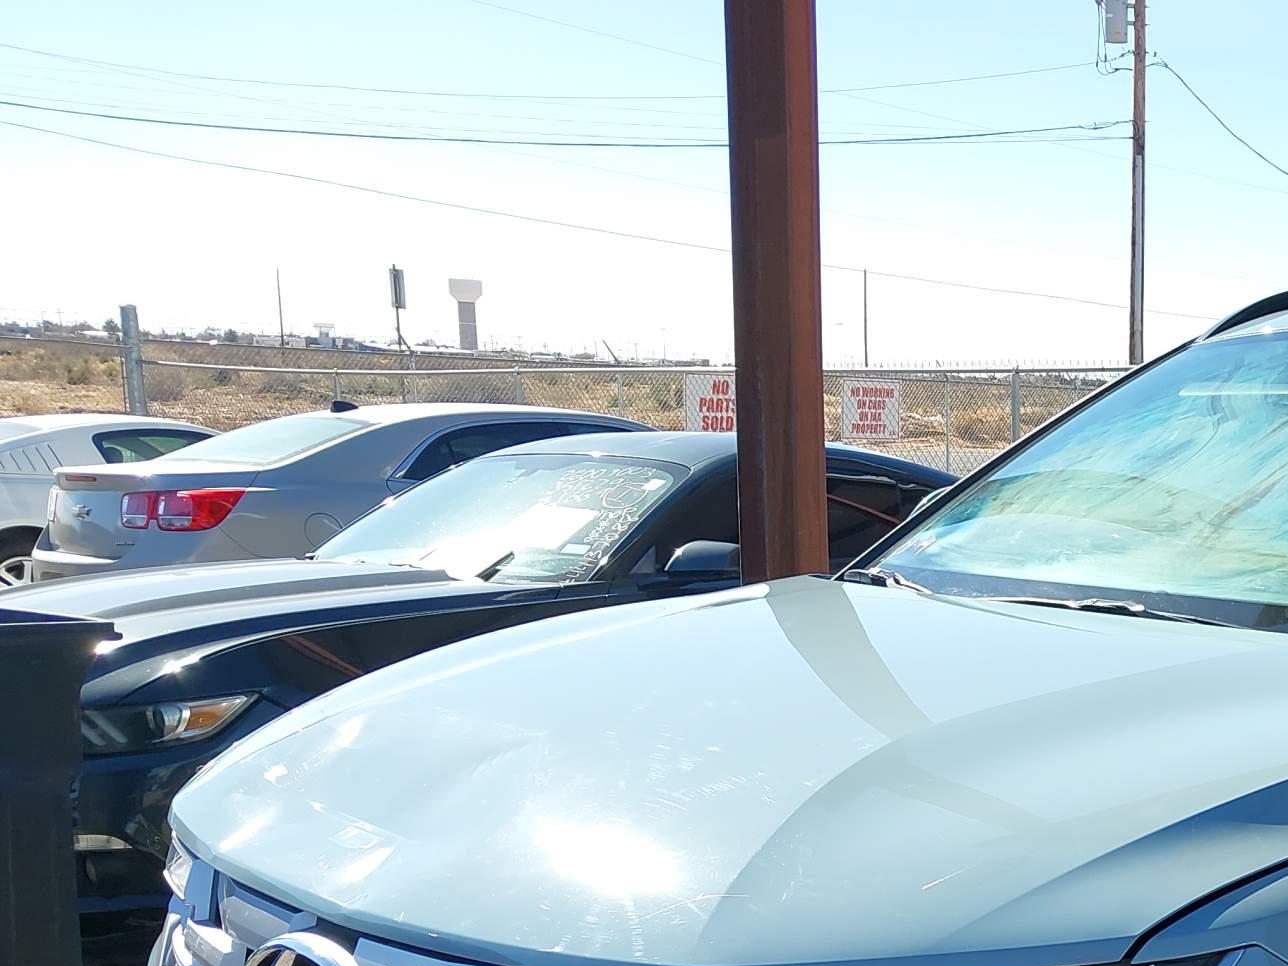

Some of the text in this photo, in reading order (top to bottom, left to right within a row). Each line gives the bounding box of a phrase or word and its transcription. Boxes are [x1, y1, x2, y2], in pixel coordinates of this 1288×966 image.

[711, 379, 730, 396] NO
[850, 386, 895, 399] NO WORKING
[857, 398, 887, 410] ON CARS
[858, 411, 868, 422] ON
[701, 415, 735, 432] SOLD
[851, 423, 888, 434] PROPERTY
